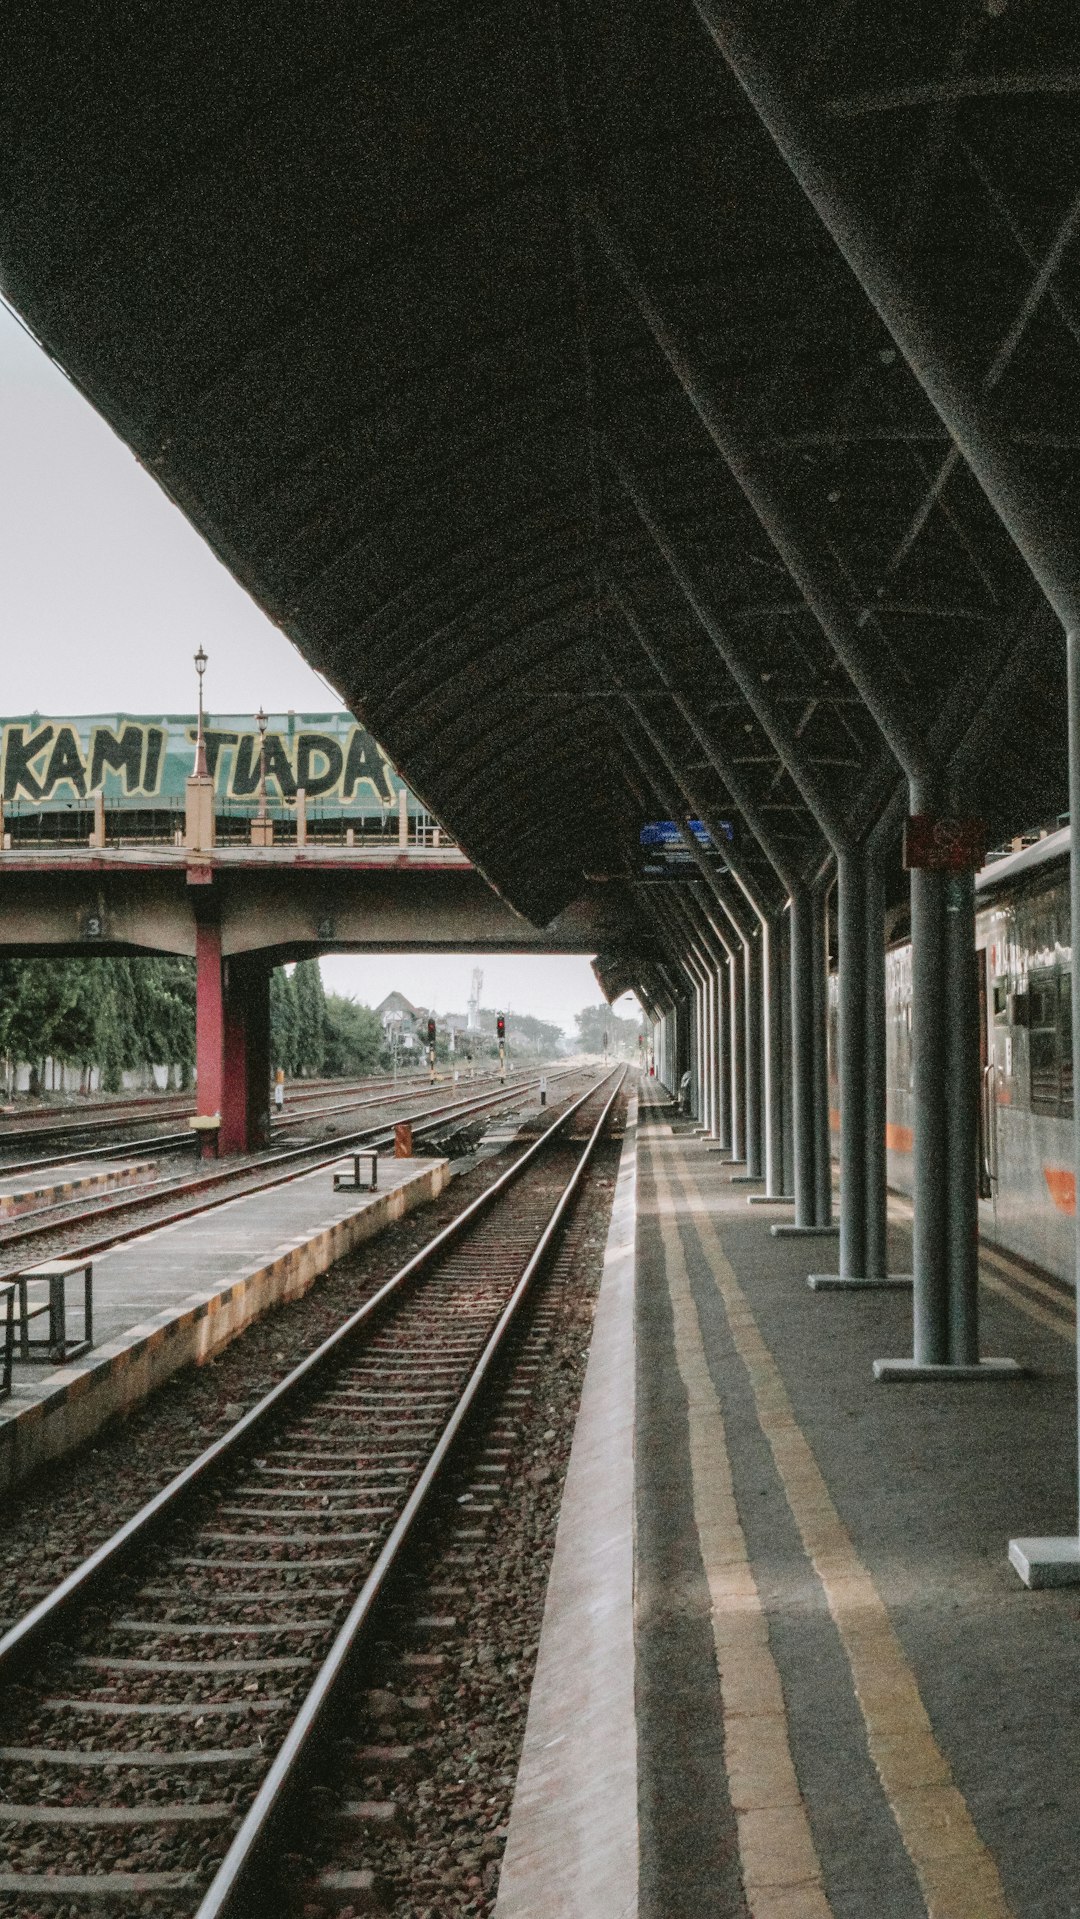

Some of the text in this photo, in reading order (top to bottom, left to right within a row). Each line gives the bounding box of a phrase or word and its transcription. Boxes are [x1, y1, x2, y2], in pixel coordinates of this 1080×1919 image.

[2, 722, 395, 806] KAMI TIADA
[89, 918, 101, 934] 3
